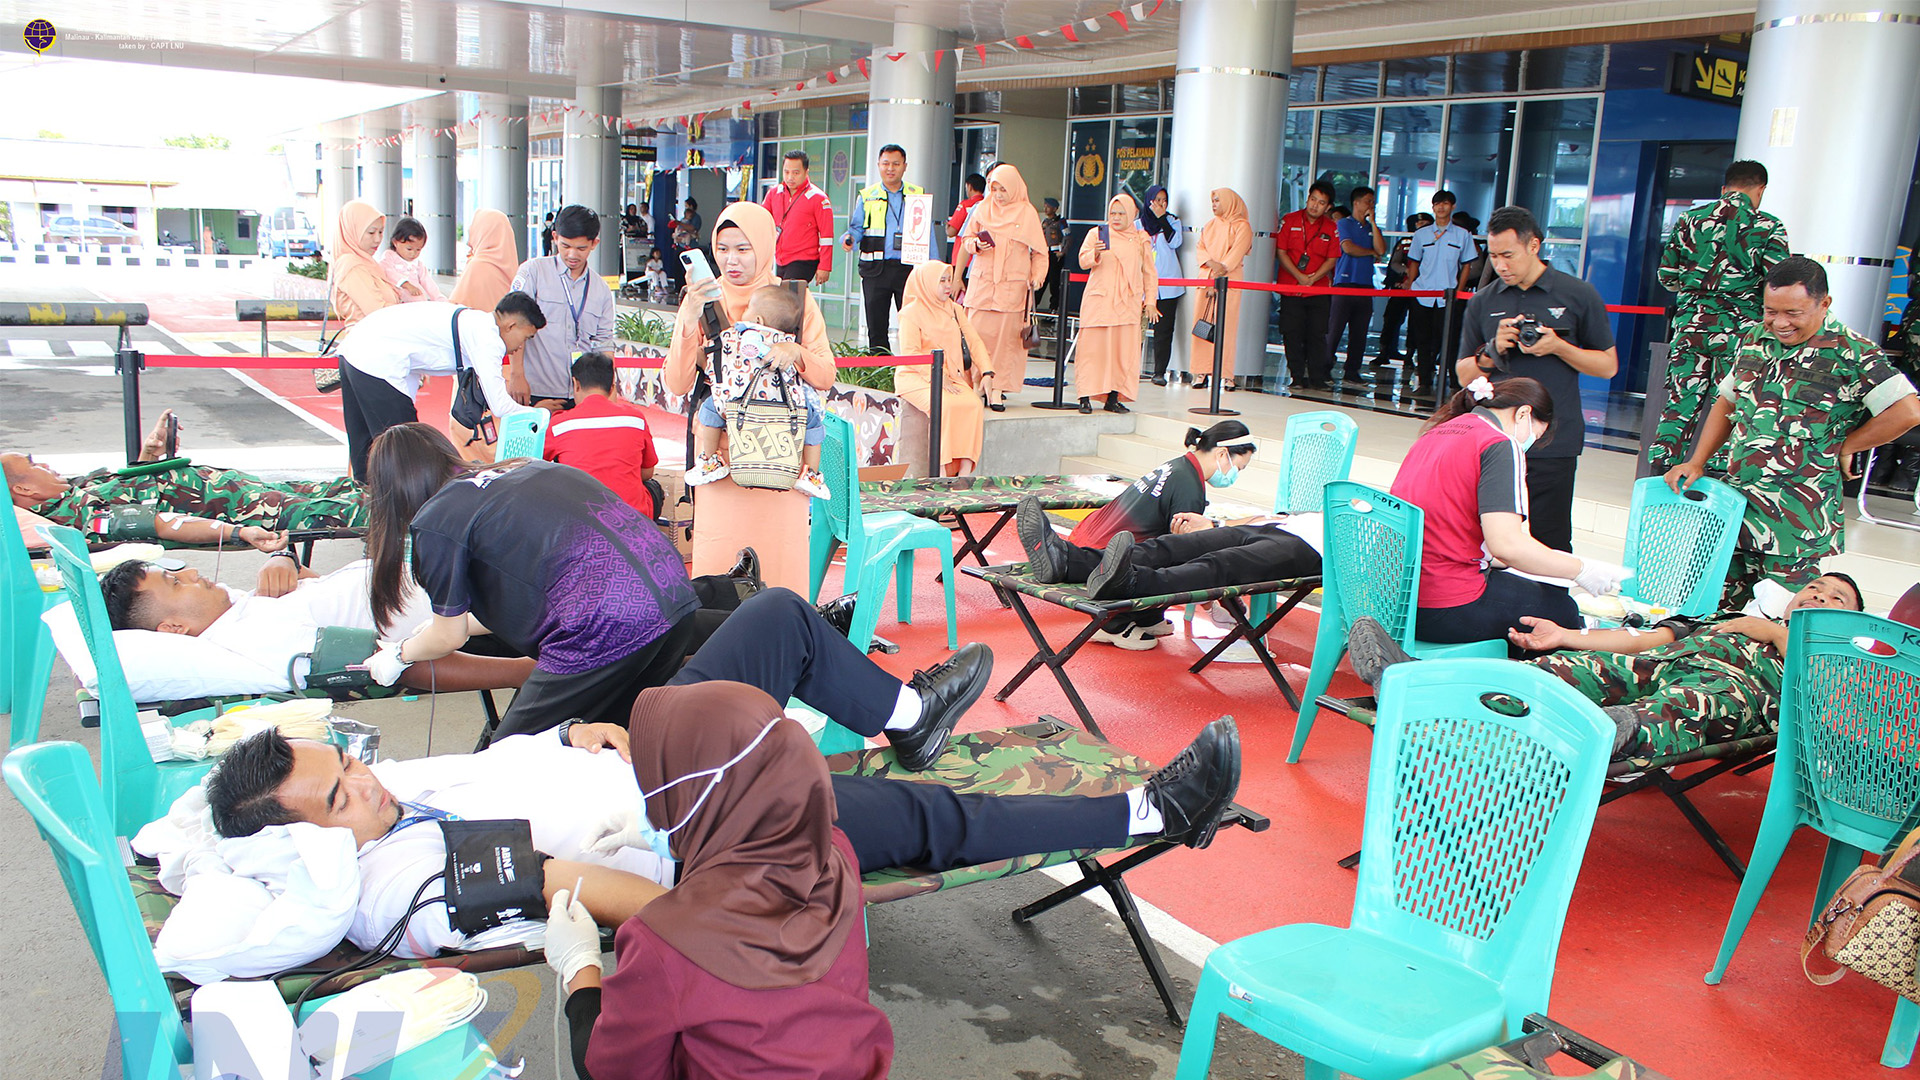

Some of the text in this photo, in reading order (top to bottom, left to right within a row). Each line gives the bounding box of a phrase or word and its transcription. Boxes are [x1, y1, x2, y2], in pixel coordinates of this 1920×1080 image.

[1116, 146, 1156, 158] POS PELAYANAN
[1121, 159, 1150, 170] KEPOLISIAN
[501, 846, 514, 868] ABN
